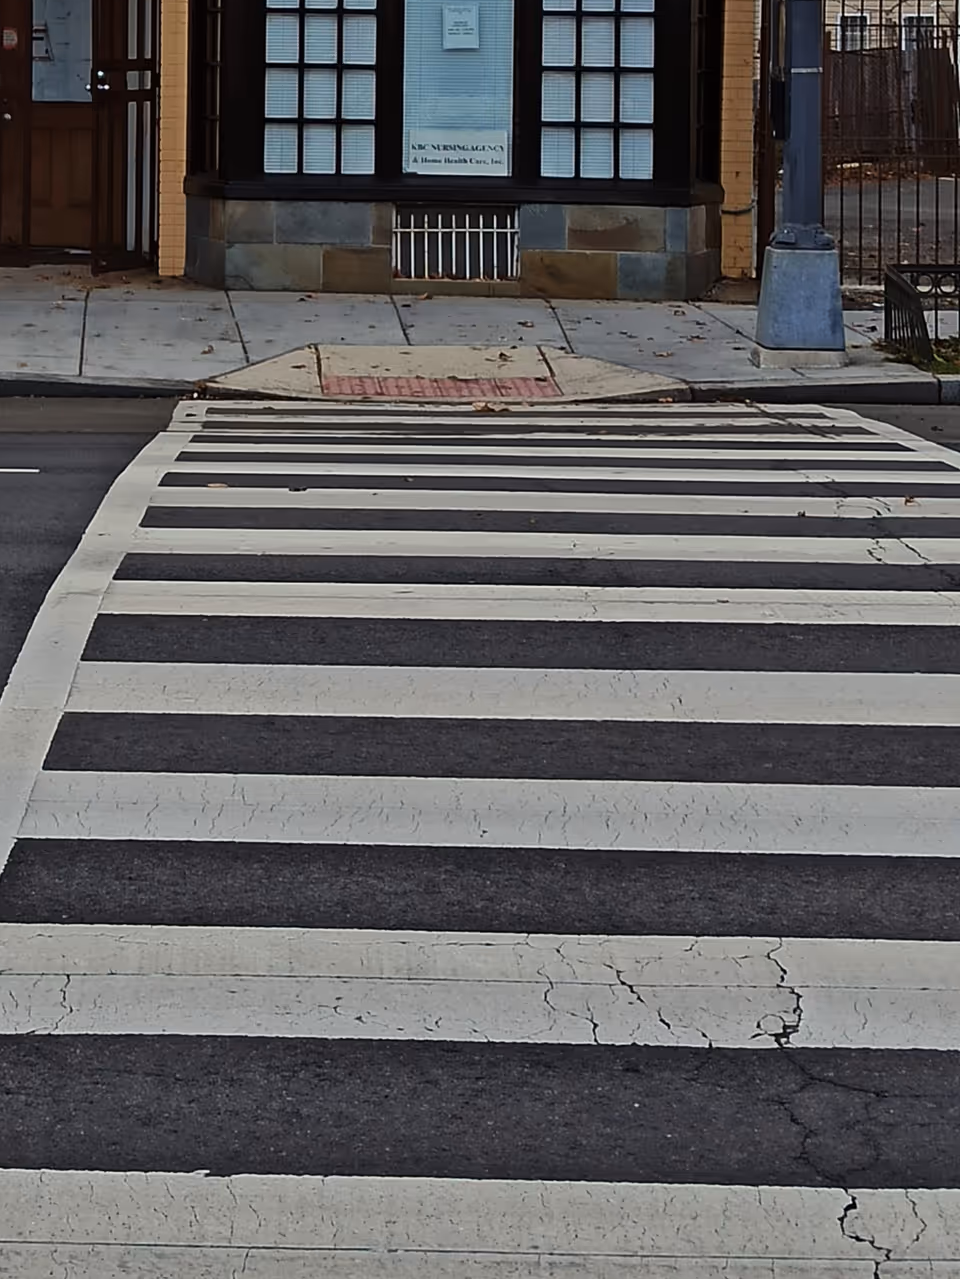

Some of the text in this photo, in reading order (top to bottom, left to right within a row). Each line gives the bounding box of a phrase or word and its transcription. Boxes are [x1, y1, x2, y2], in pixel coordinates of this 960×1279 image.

[411, 143, 505, 152] KBC NURSING AGENCY
